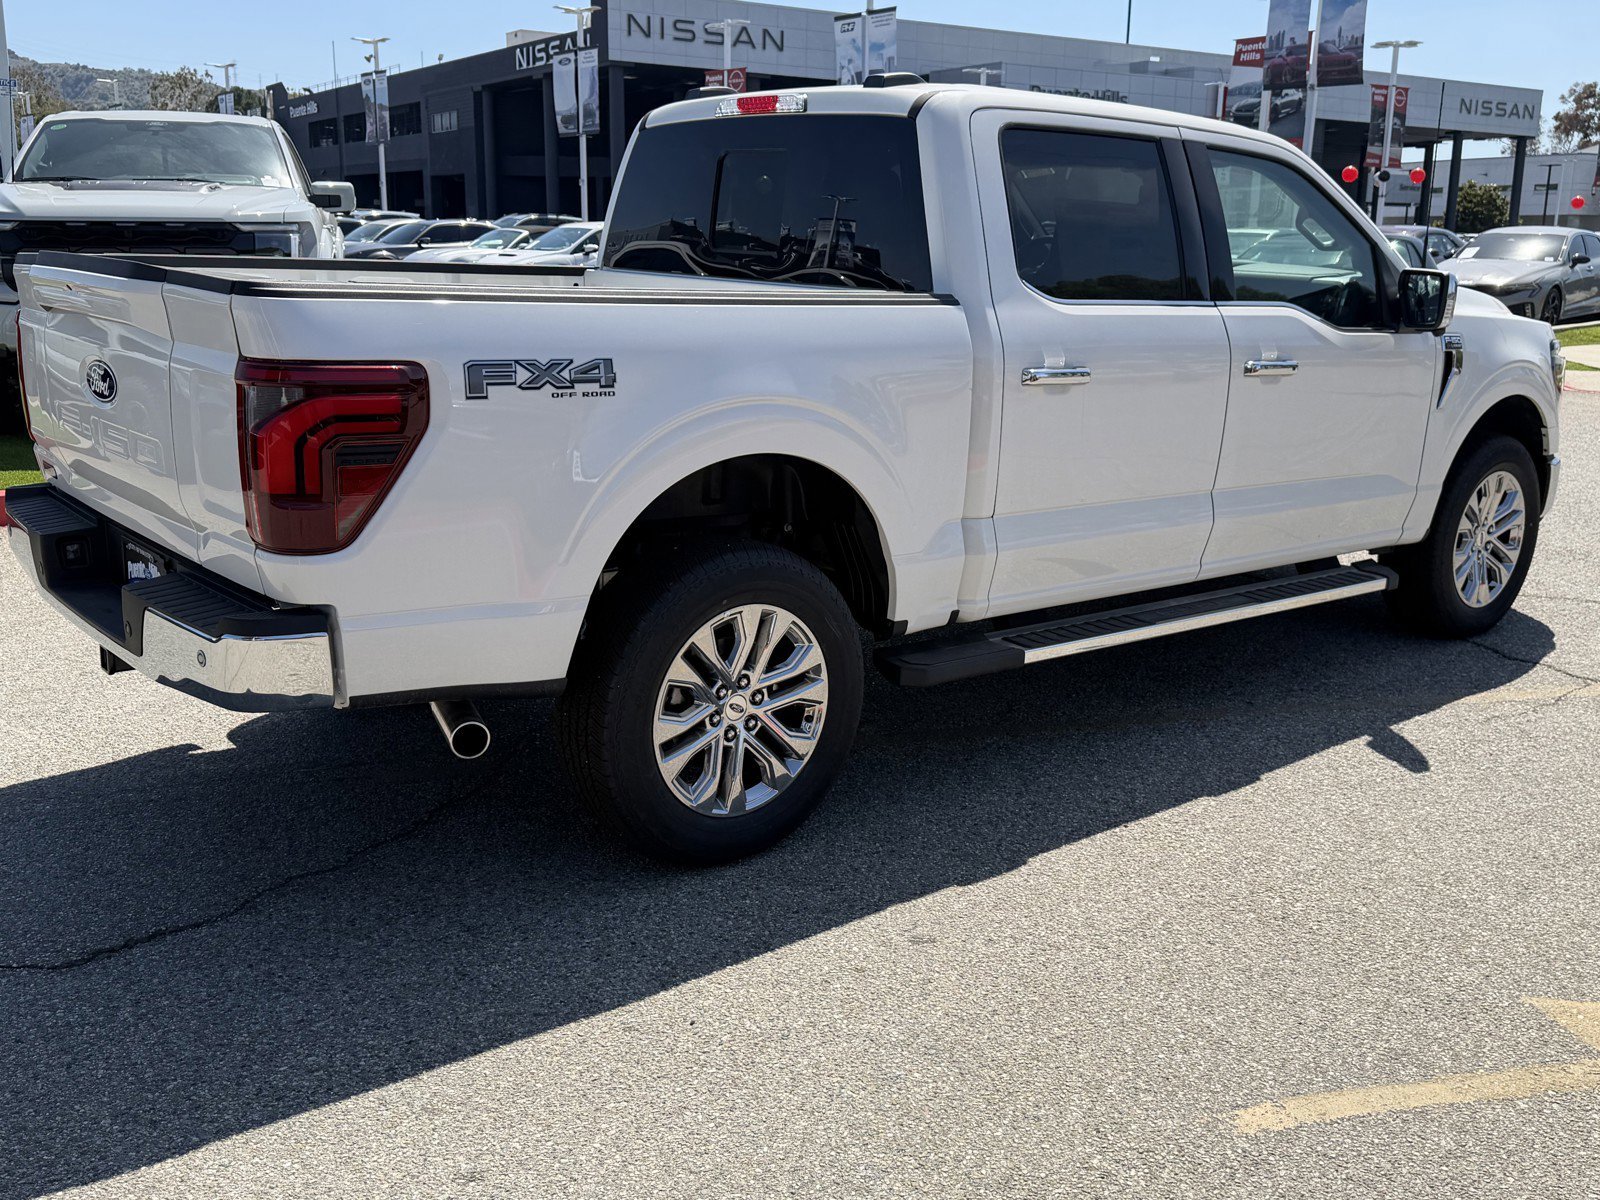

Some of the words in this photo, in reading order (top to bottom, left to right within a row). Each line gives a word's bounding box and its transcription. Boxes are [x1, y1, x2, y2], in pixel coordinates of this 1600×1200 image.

[627, 13, 784, 52] NISSAN
[1240, 52, 1261, 61] Hills
[289, 105, 307, 119] Puente
[306, 100, 318, 115] Hills
[1459, 97, 1535, 120] NISSAN
[87, 366, 111, 397] Ford
[463, 358, 617, 400] FX4
[551, 391, 578, 399] OFF
[582, 390, 616, 398] ROAD
[127, 560, 146, 580] Puente
